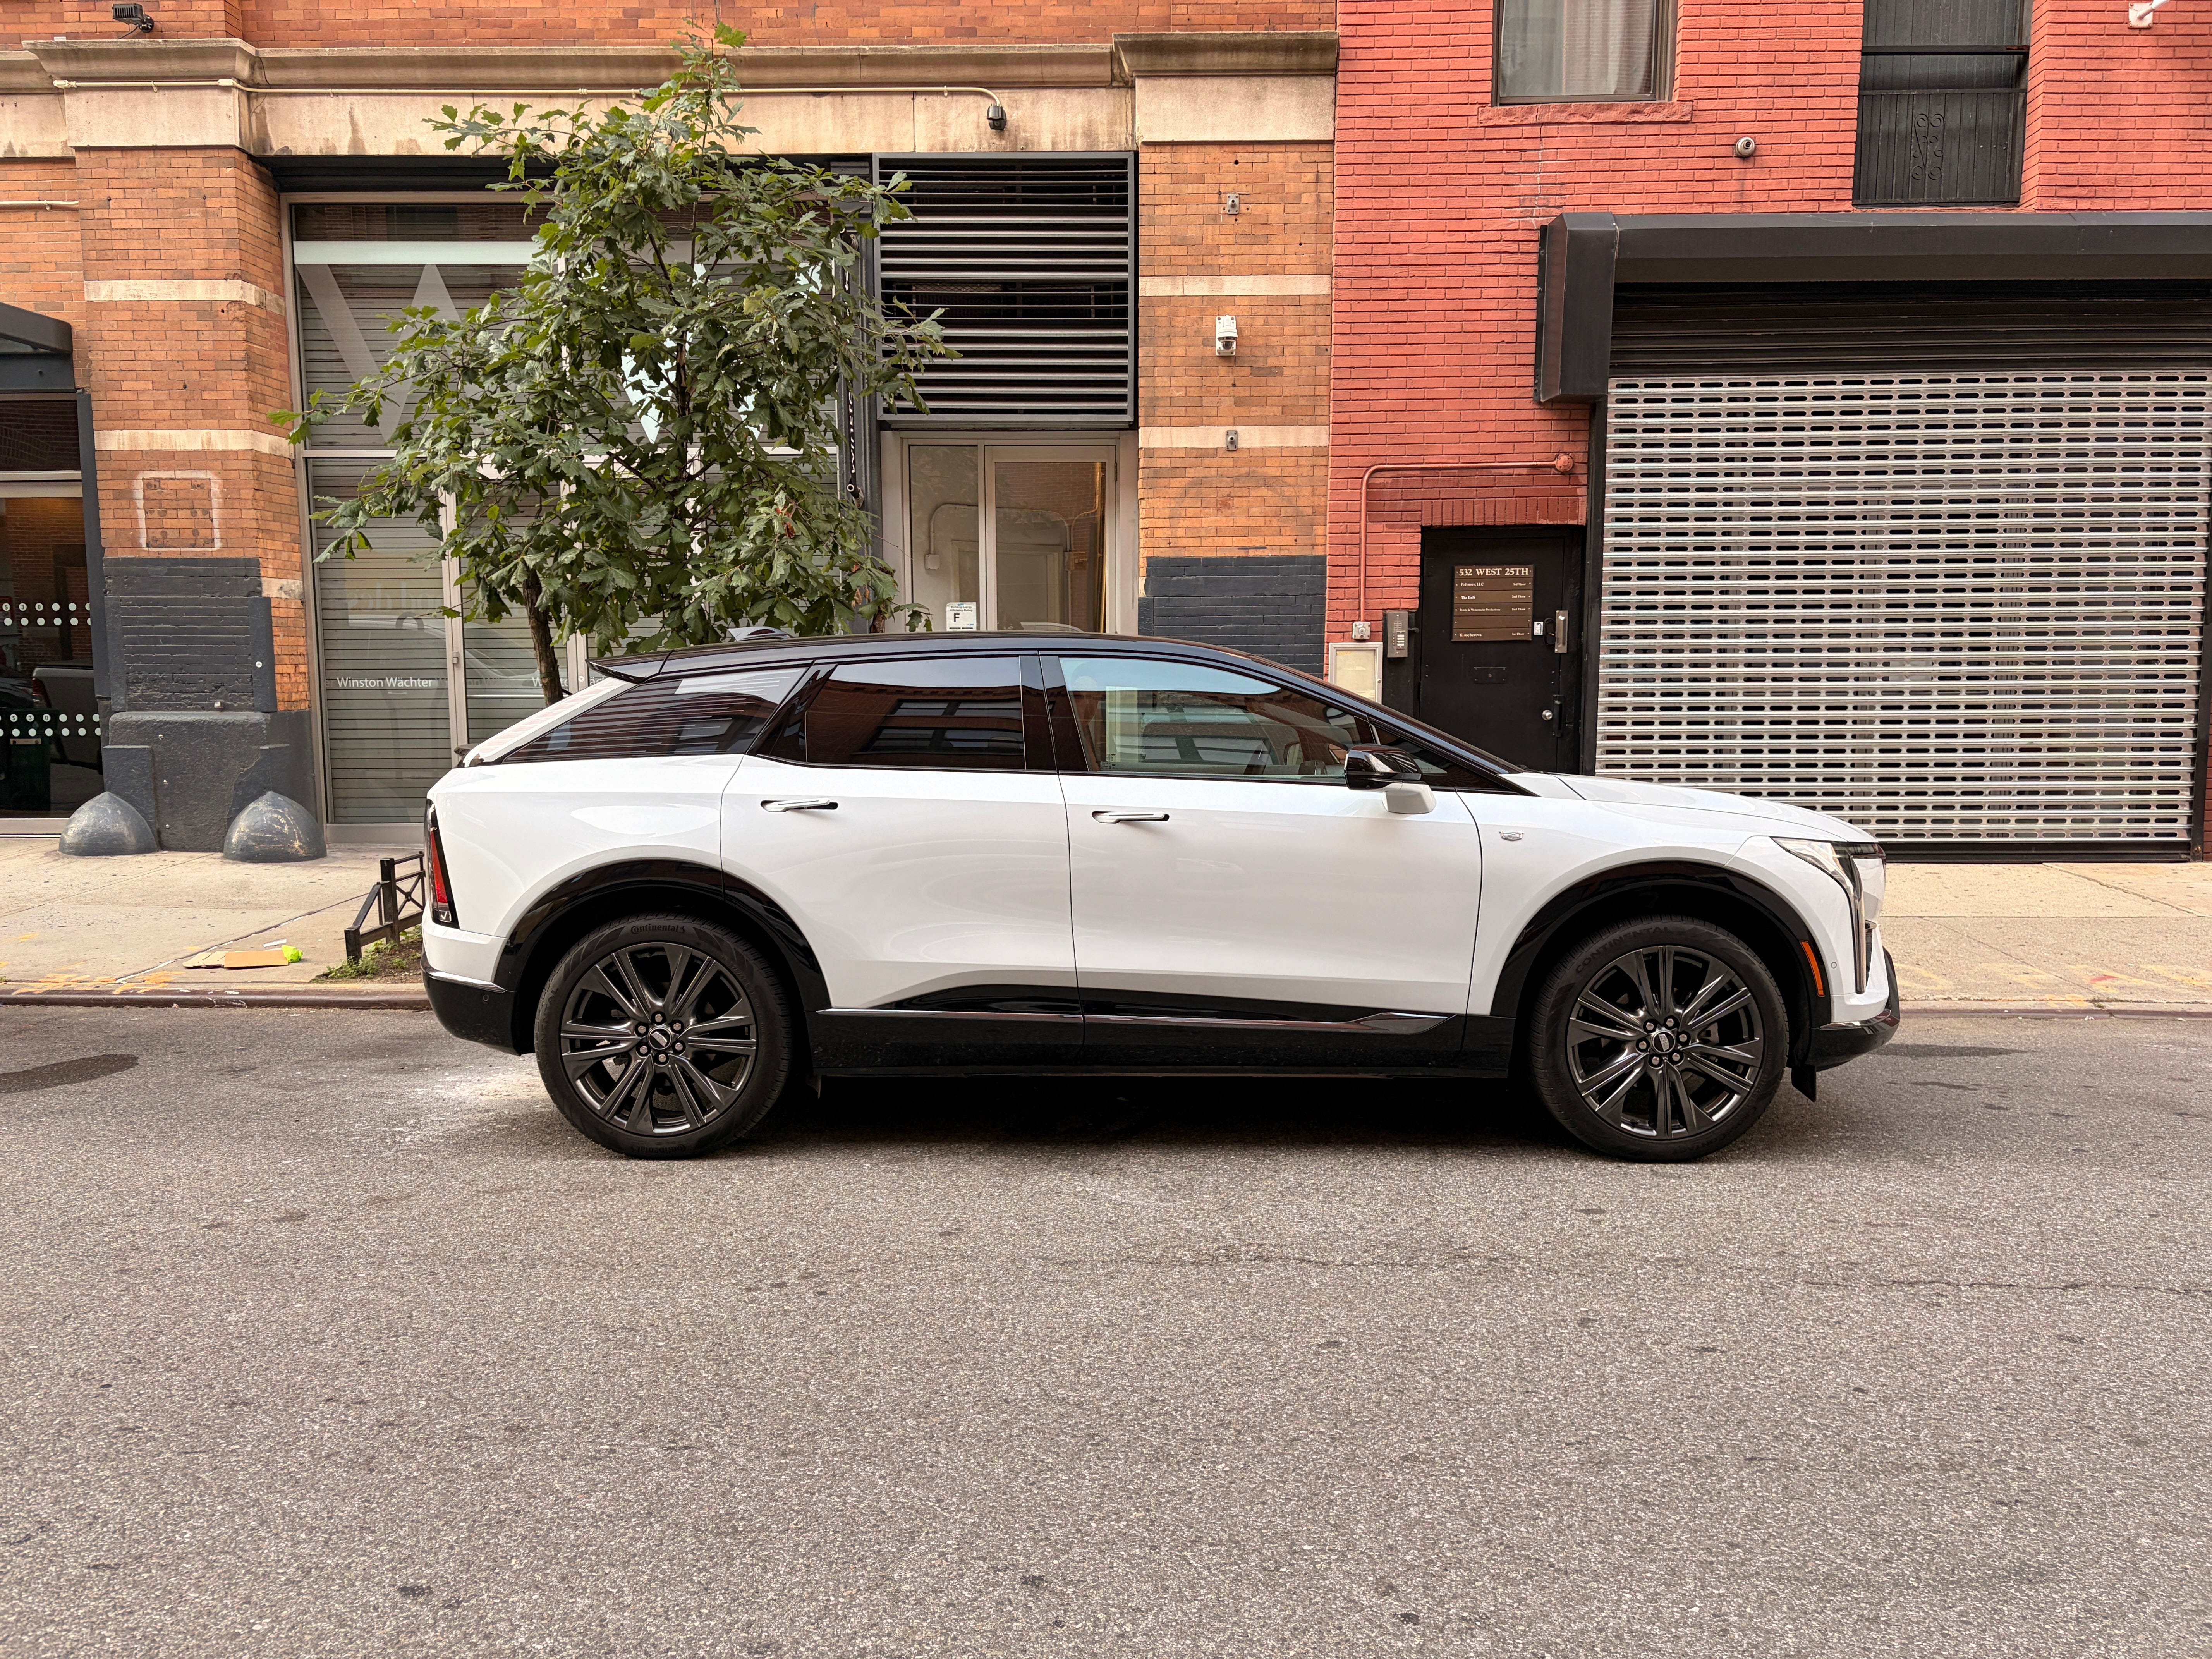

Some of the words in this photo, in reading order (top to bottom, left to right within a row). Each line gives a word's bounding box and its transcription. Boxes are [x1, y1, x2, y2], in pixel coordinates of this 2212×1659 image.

[953, 613, 960, 622] F
[337, 677, 383, 687] Winston
[386, 677, 433, 687] Wächter
[630, 924, 679, 935] Continental
[1575, 926, 1672, 974] CONTINENTAL
